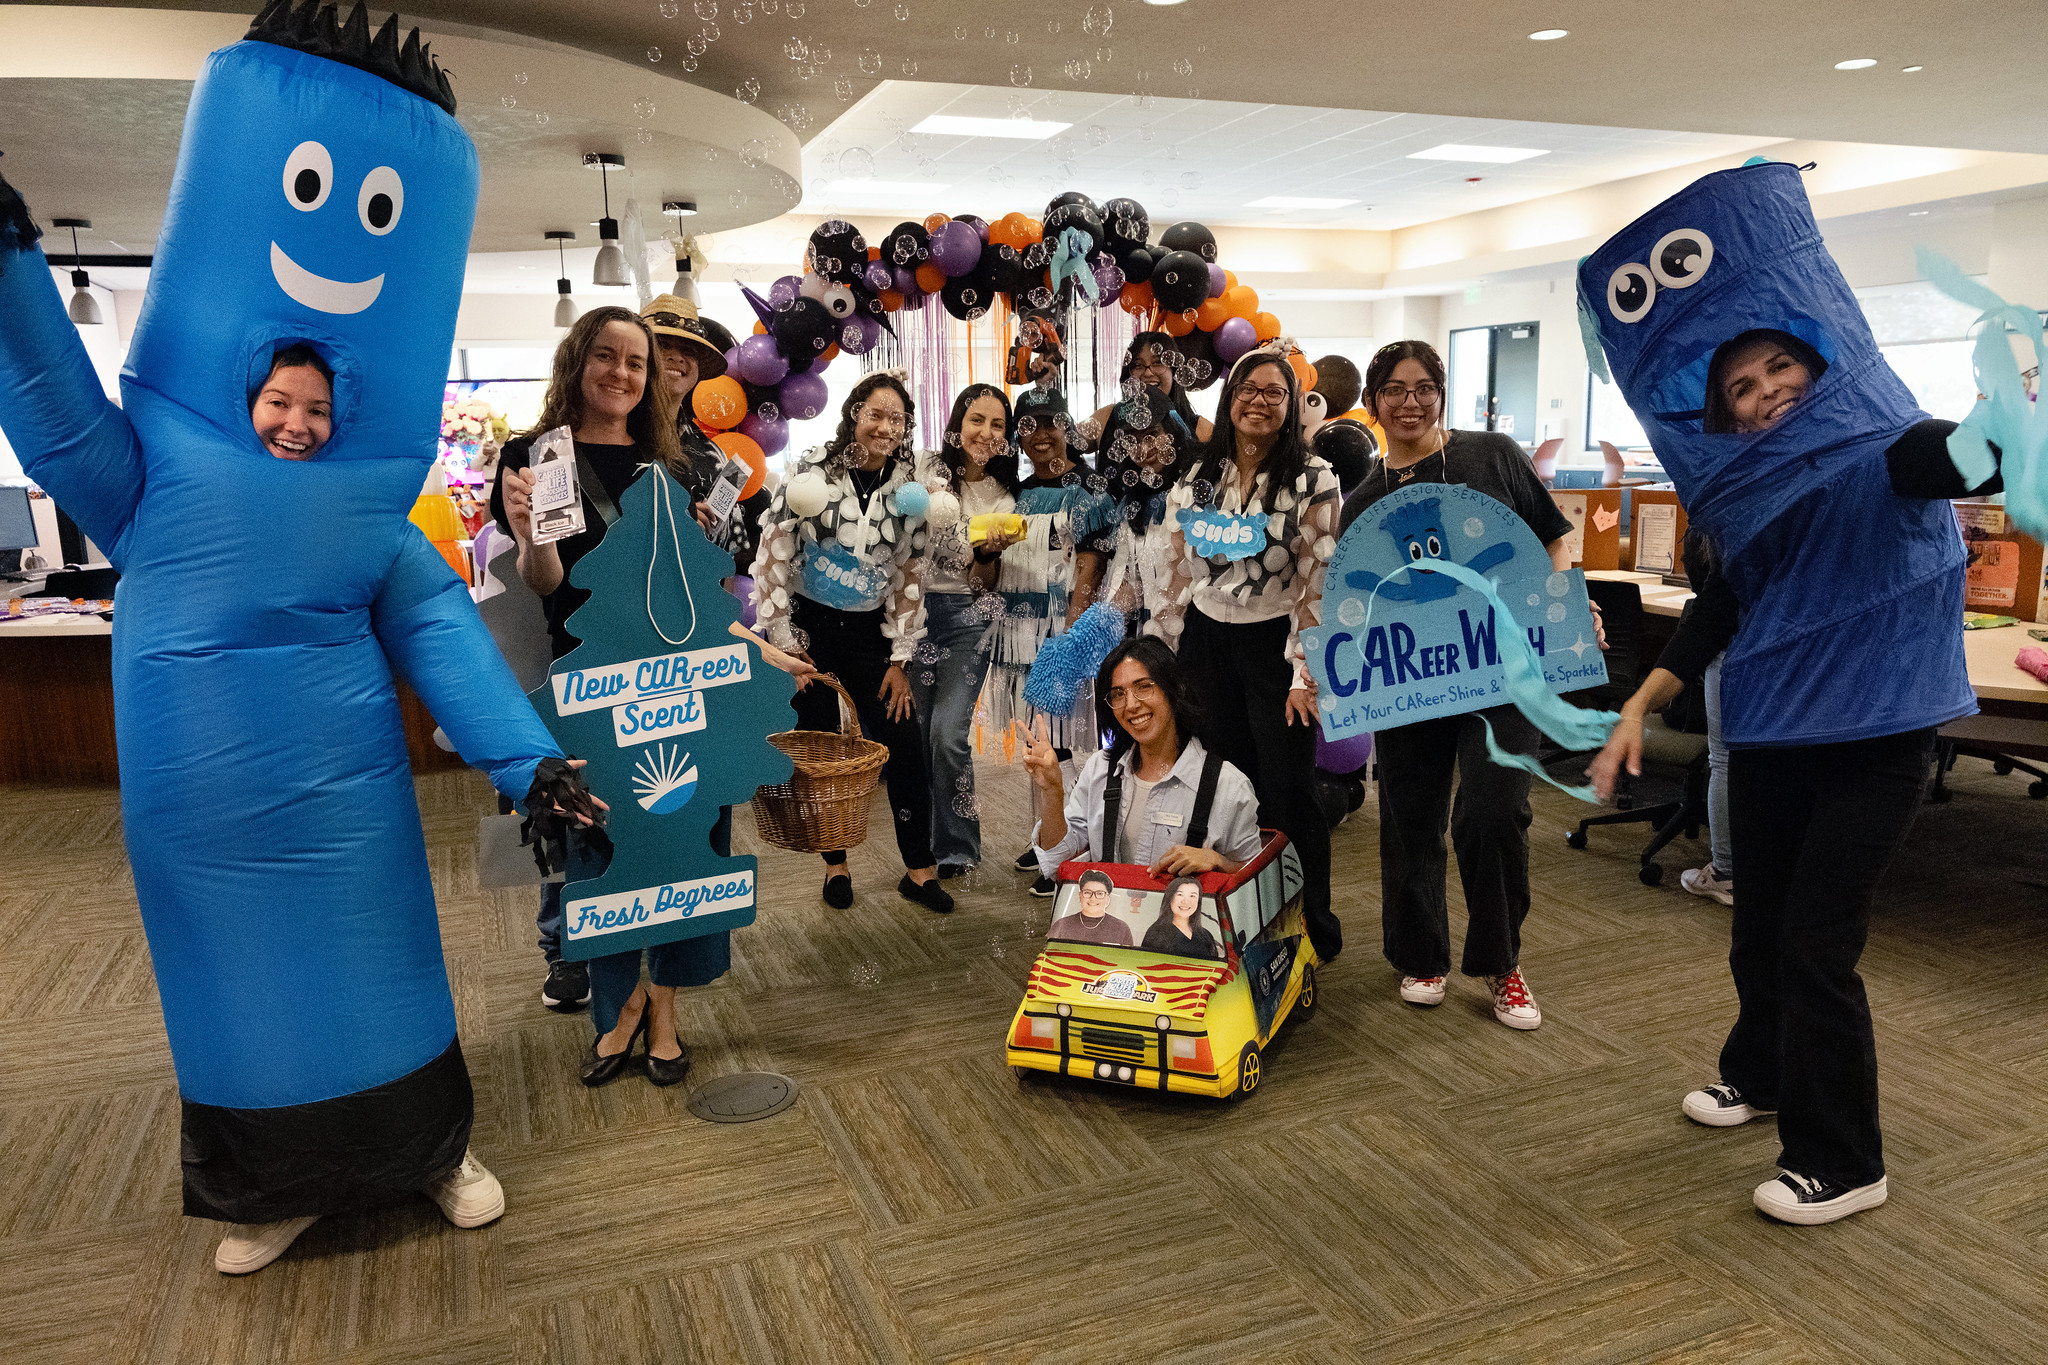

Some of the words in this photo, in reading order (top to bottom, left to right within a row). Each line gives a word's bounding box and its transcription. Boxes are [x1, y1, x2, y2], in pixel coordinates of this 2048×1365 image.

[538, 467, 565, 482] CAREER
[548, 475, 567, 489] LIFE
[540, 492, 568, 505] SERVICES
[1191, 519, 1254, 544] suds
[1326, 536, 1354, 591] CAREER
[1353, 522, 1362, 534] &
[1361, 500, 1389, 524] LIFE
[1394, 485, 1446, 503] DESIGN
[1450, 487, 1519, 527] SERVICES
[814, 555, 869, 592] suds
[1458, 604, 1545, 670] WH
[562, 670, 630, 705] New
[635, 655, 747, 696] CAR-eer
[1328, 708, 1357, 730] Let
[1361, 704, 1393, 721] Your
[1395, 691, 1447, 712] CAReer
[1448, 684, 1486, 702] Shine
[1490, 679, 1501, 694] &
[1543, 670, 1557, 684] fe
[1558, 661, 1605, 684] Sparkle!
[620, 692, 700, 735] Scent
[568, 896, 650, 935] Fresh
[653, 878, 753, 917] Degrees
